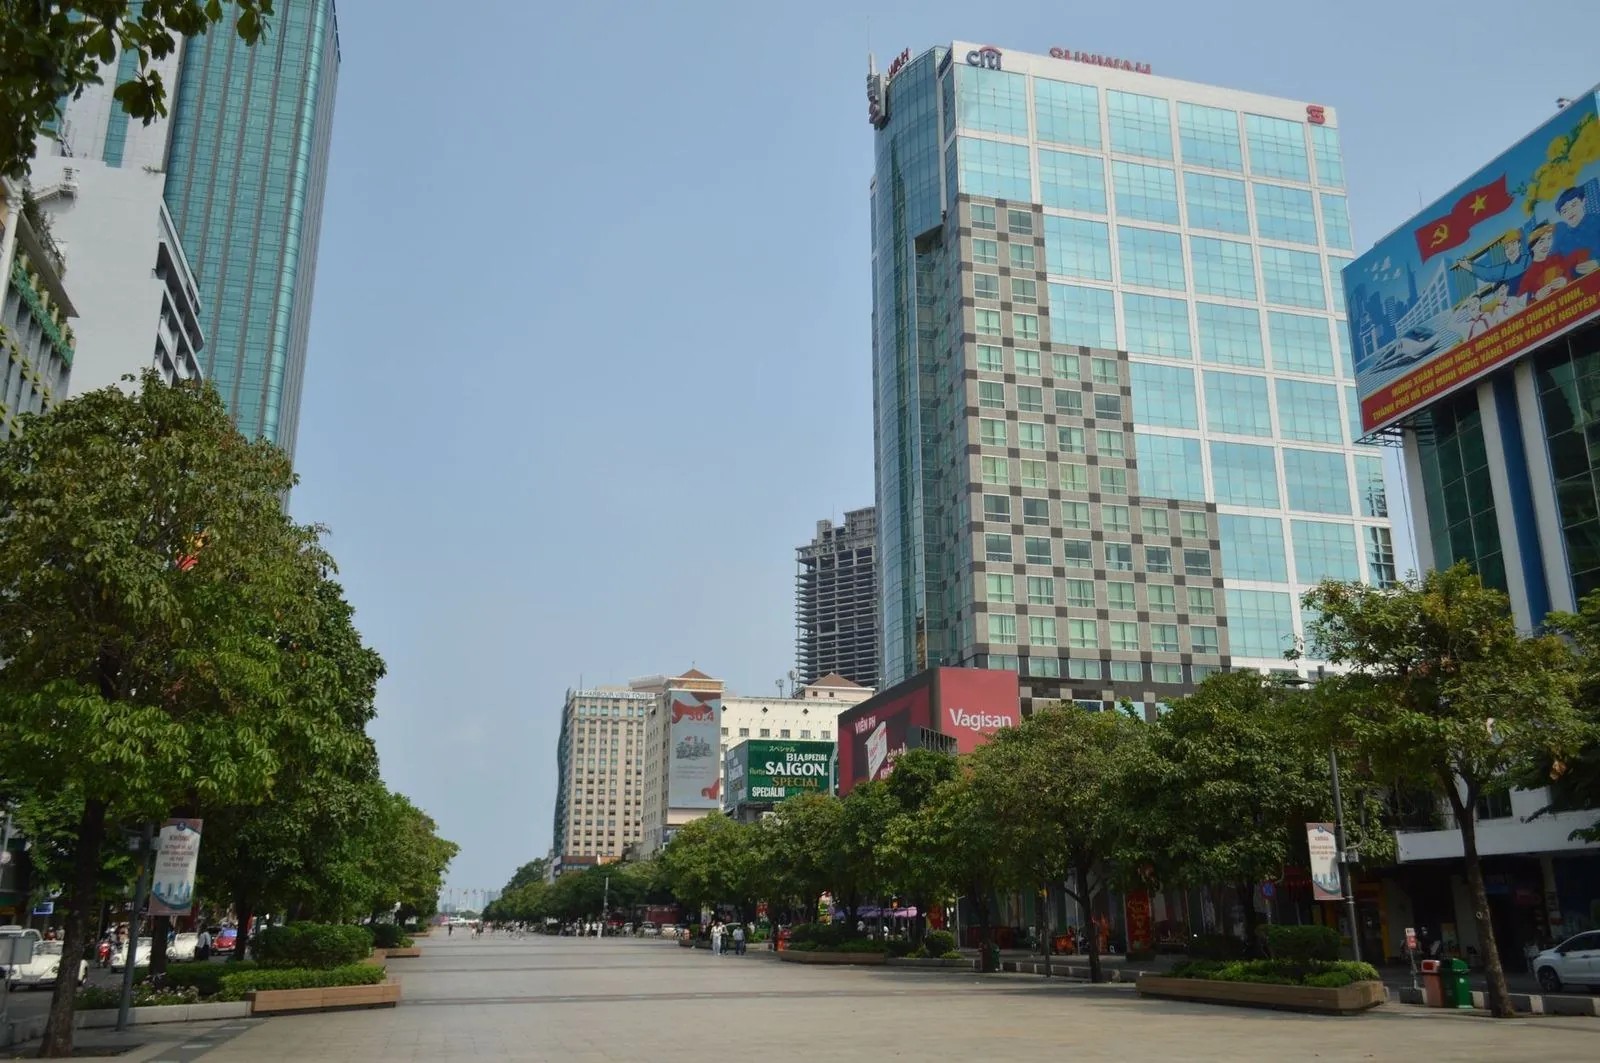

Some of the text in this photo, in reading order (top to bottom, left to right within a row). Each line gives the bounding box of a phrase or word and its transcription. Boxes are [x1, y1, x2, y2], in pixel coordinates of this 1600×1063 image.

[1526, 301, 1557, 323] QUANG
[1558, 287, 1584, 306] VINH,
[949, 708, 1012, 731] Vagisan
[786, 753, 804, 762] BIA
[765, 761, 826, 776] SAIGON
[772, 777, 820, 787] SPECIAL
